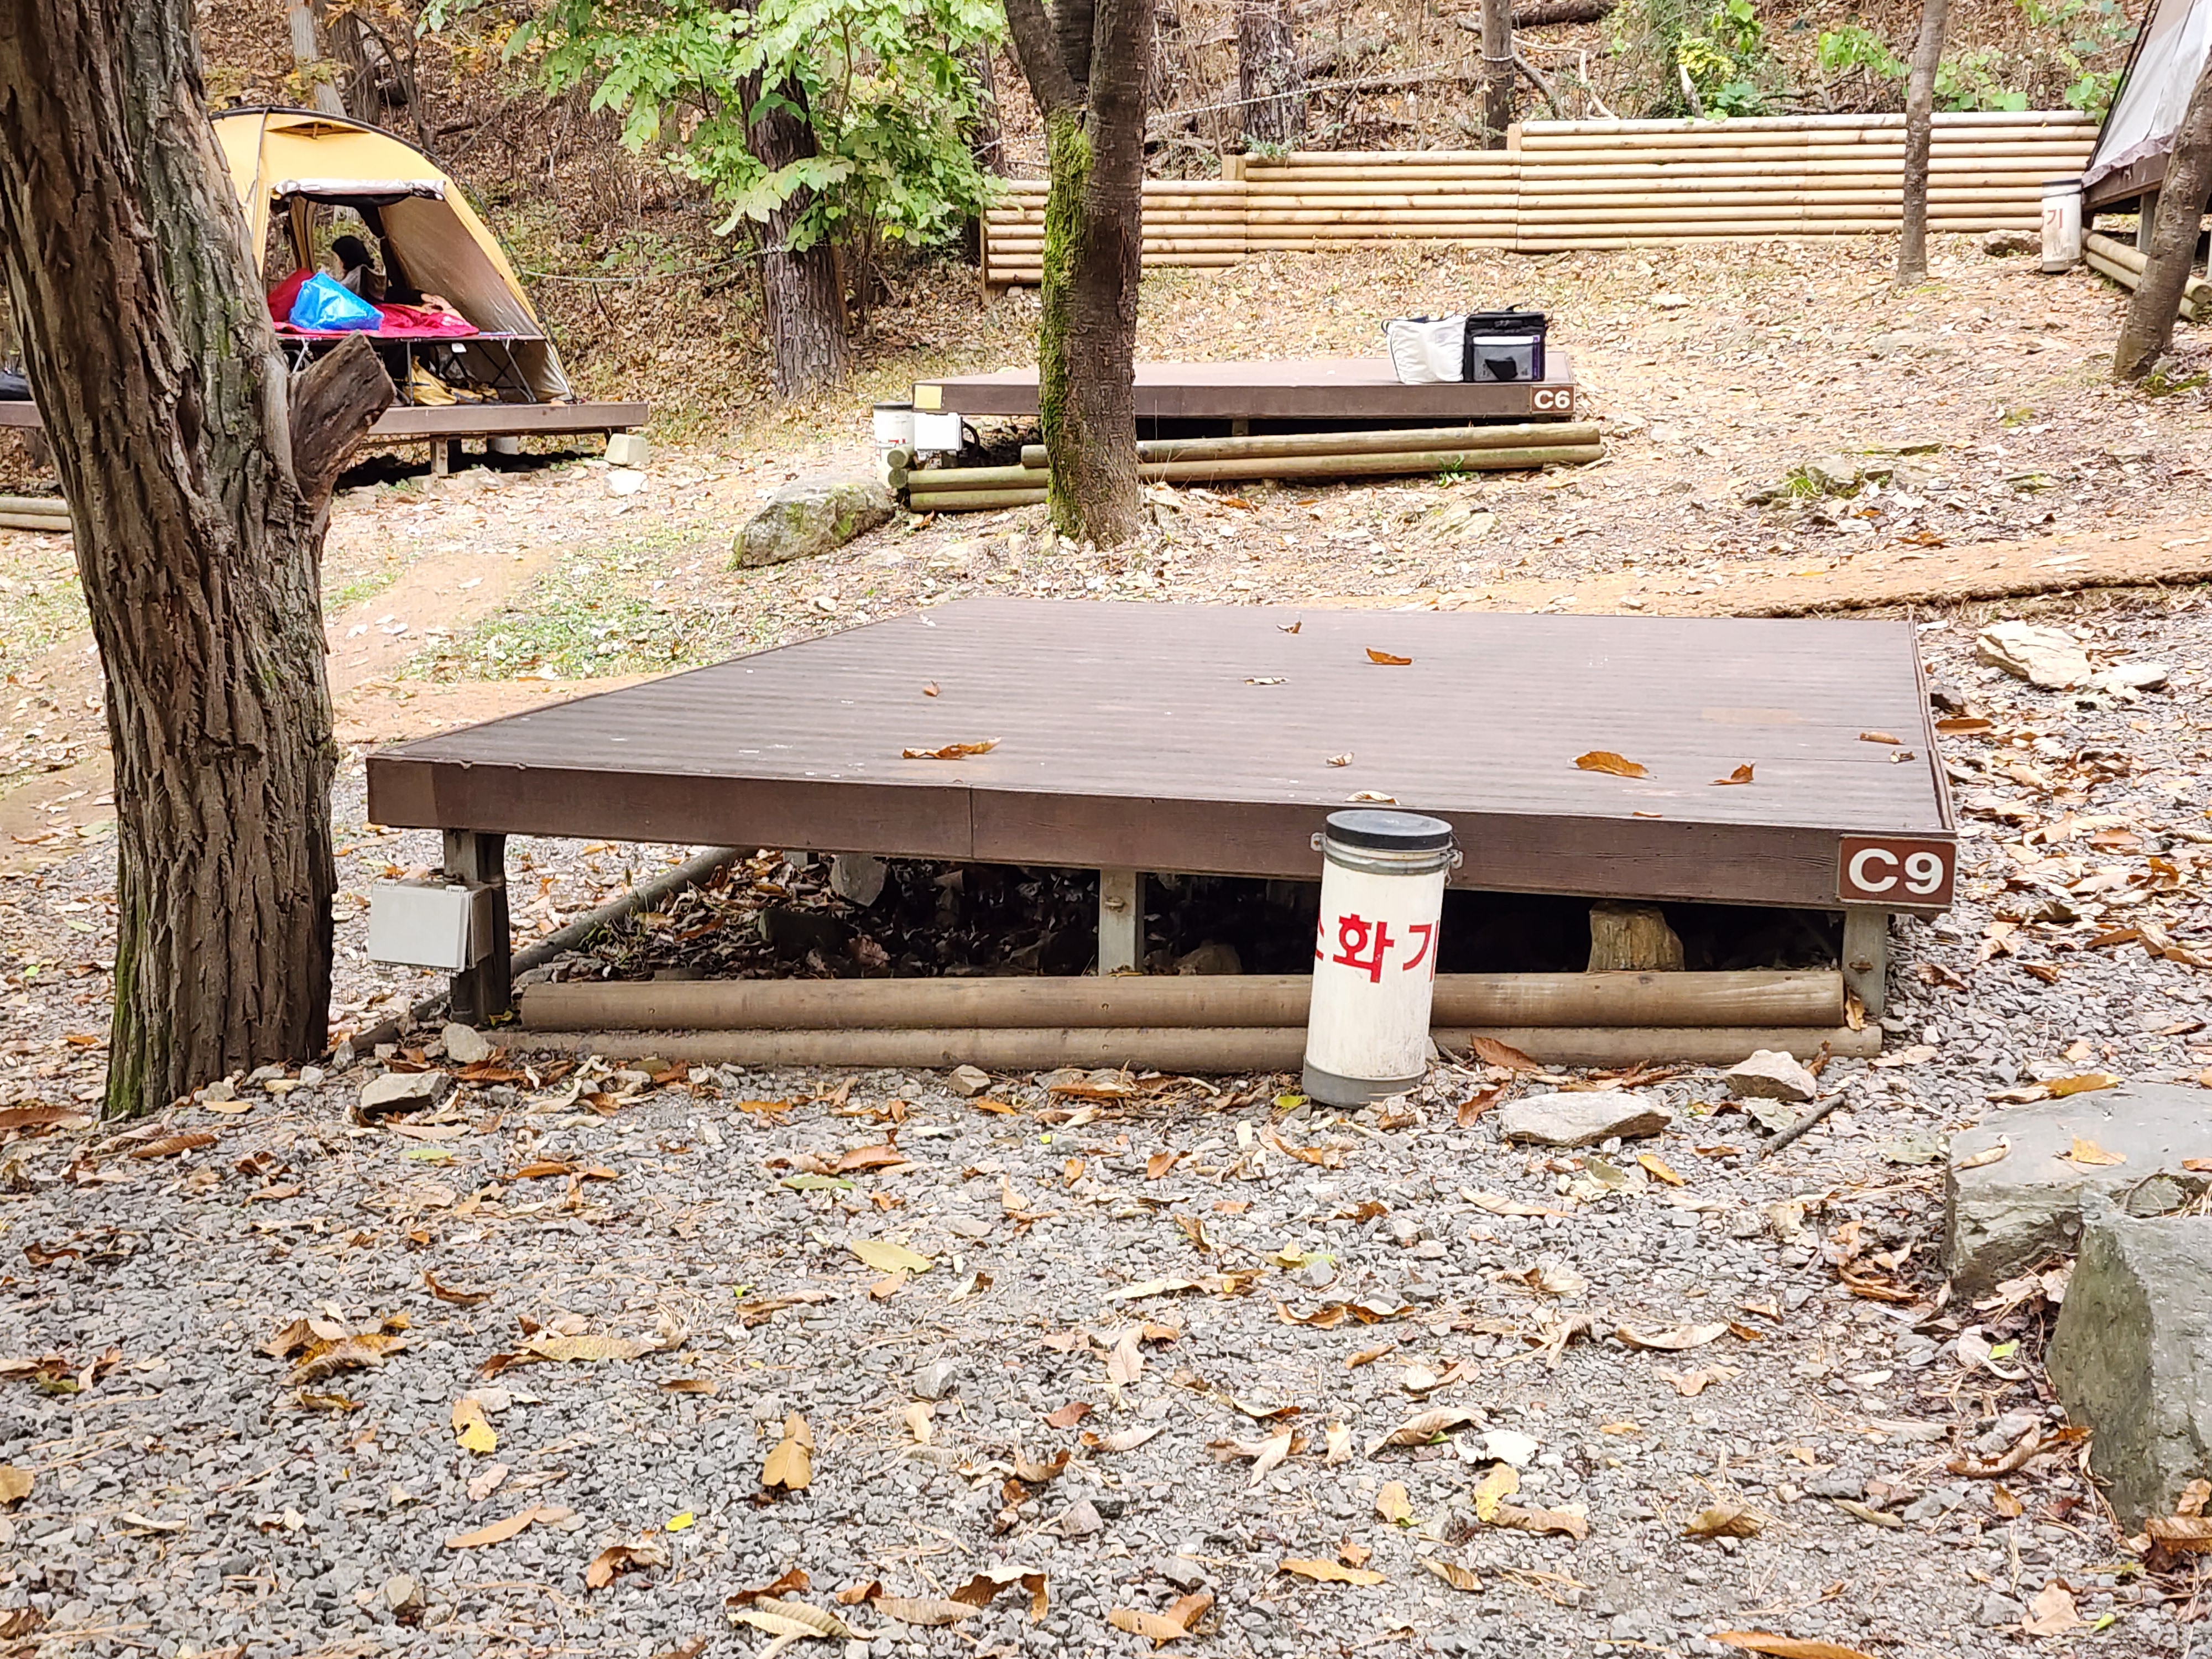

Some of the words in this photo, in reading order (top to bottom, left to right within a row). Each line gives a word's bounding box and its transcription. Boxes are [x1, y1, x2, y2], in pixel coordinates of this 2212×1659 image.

[2042, 208, 2063, 229] 기
[1534, 390, 1571, 409] C6
[1849, 848, 1944, 894] C9
[1316, 909, 1439, 983] 화기
